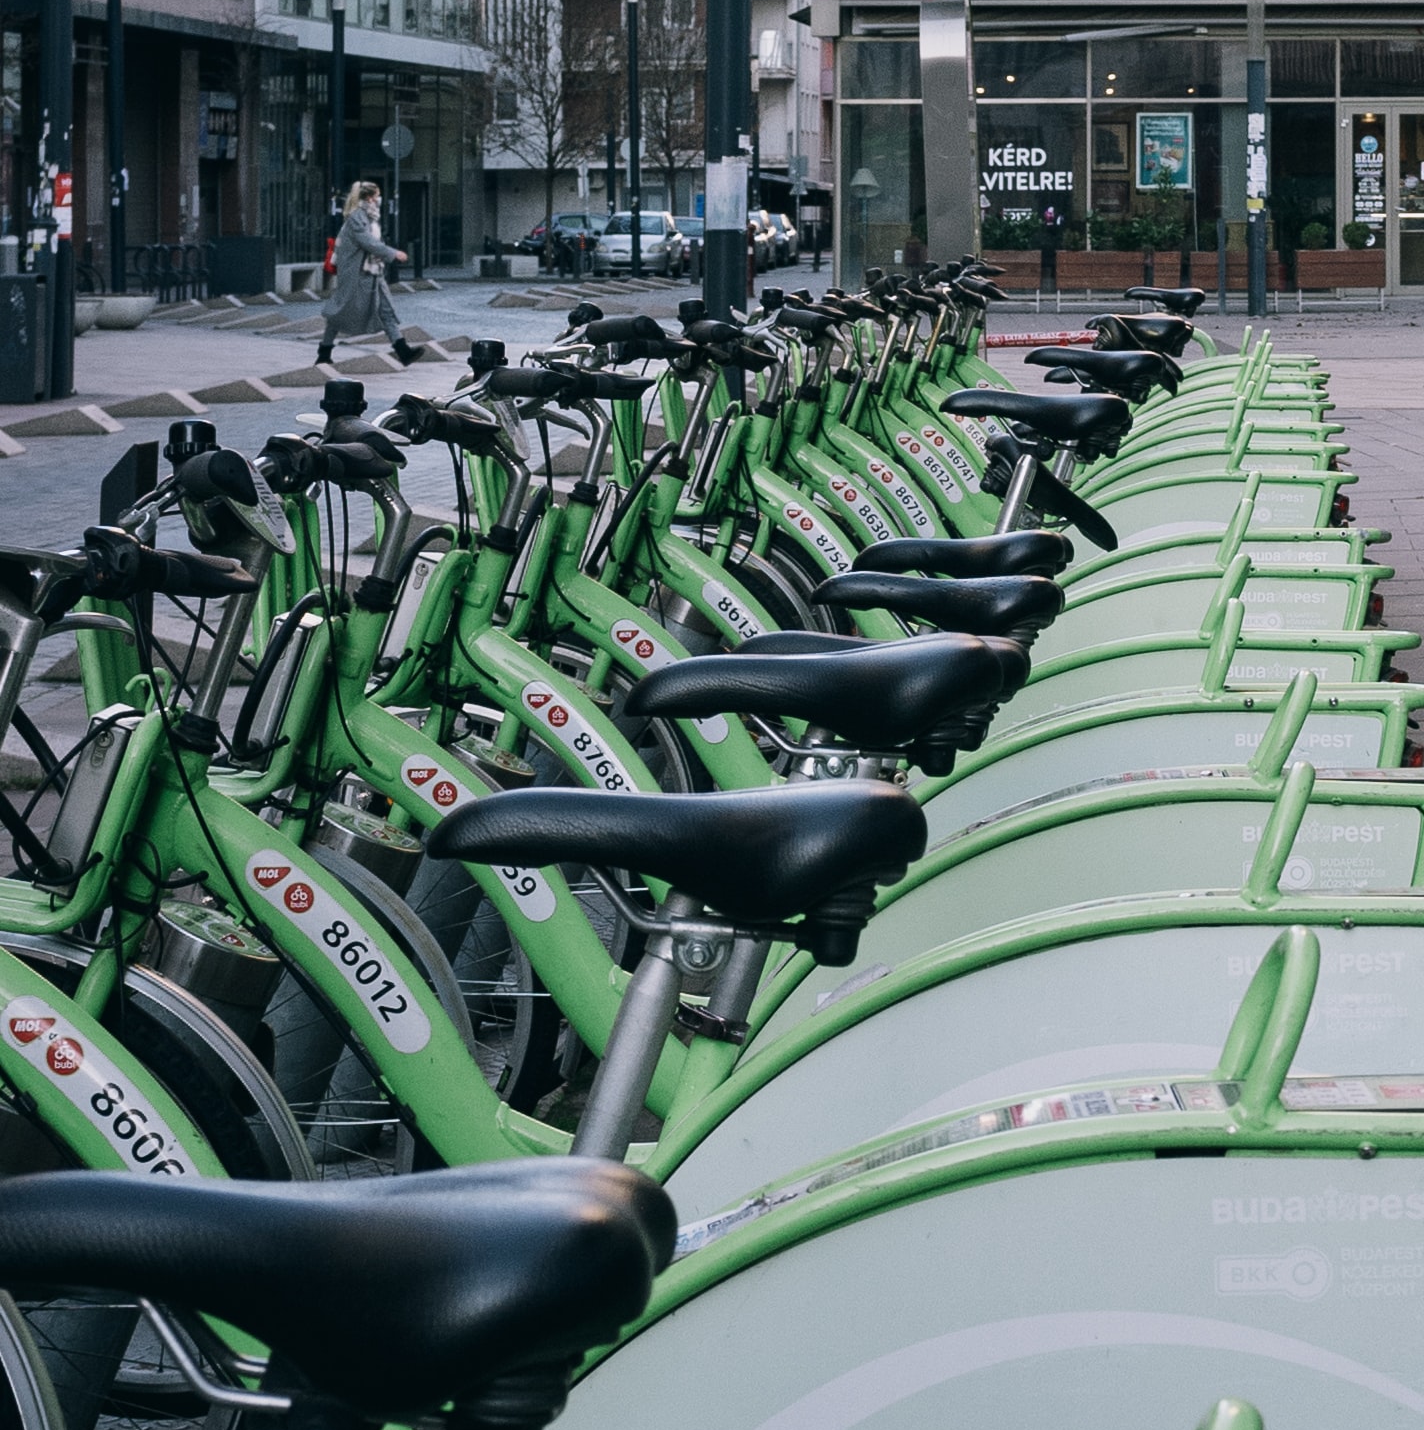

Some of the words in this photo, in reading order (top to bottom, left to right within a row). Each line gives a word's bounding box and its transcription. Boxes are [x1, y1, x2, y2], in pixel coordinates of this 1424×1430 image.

[988, 142, 1047, 167] KÉRD
[1354, 153, 1383, 163] HELLO
[979, 171, 1073, 191] VITELRE!
[923, 456, 954, 491] 86121
[946, 448, 974, 482] 86741
[859, 505, 892, 541] 8630
[895, 486, 928, 526] 86719
[816, 534, 849, 571] 8754
[718, 597, 758, 639] 8613
[573, 732, 632, 792] 8768
[257, 869, 279, 879] MOL
[322, 920, 408, 1022] 86012
[14, 1020, 41, 1032] MOL
[1231, 1266, 1279, 1283] BKK
